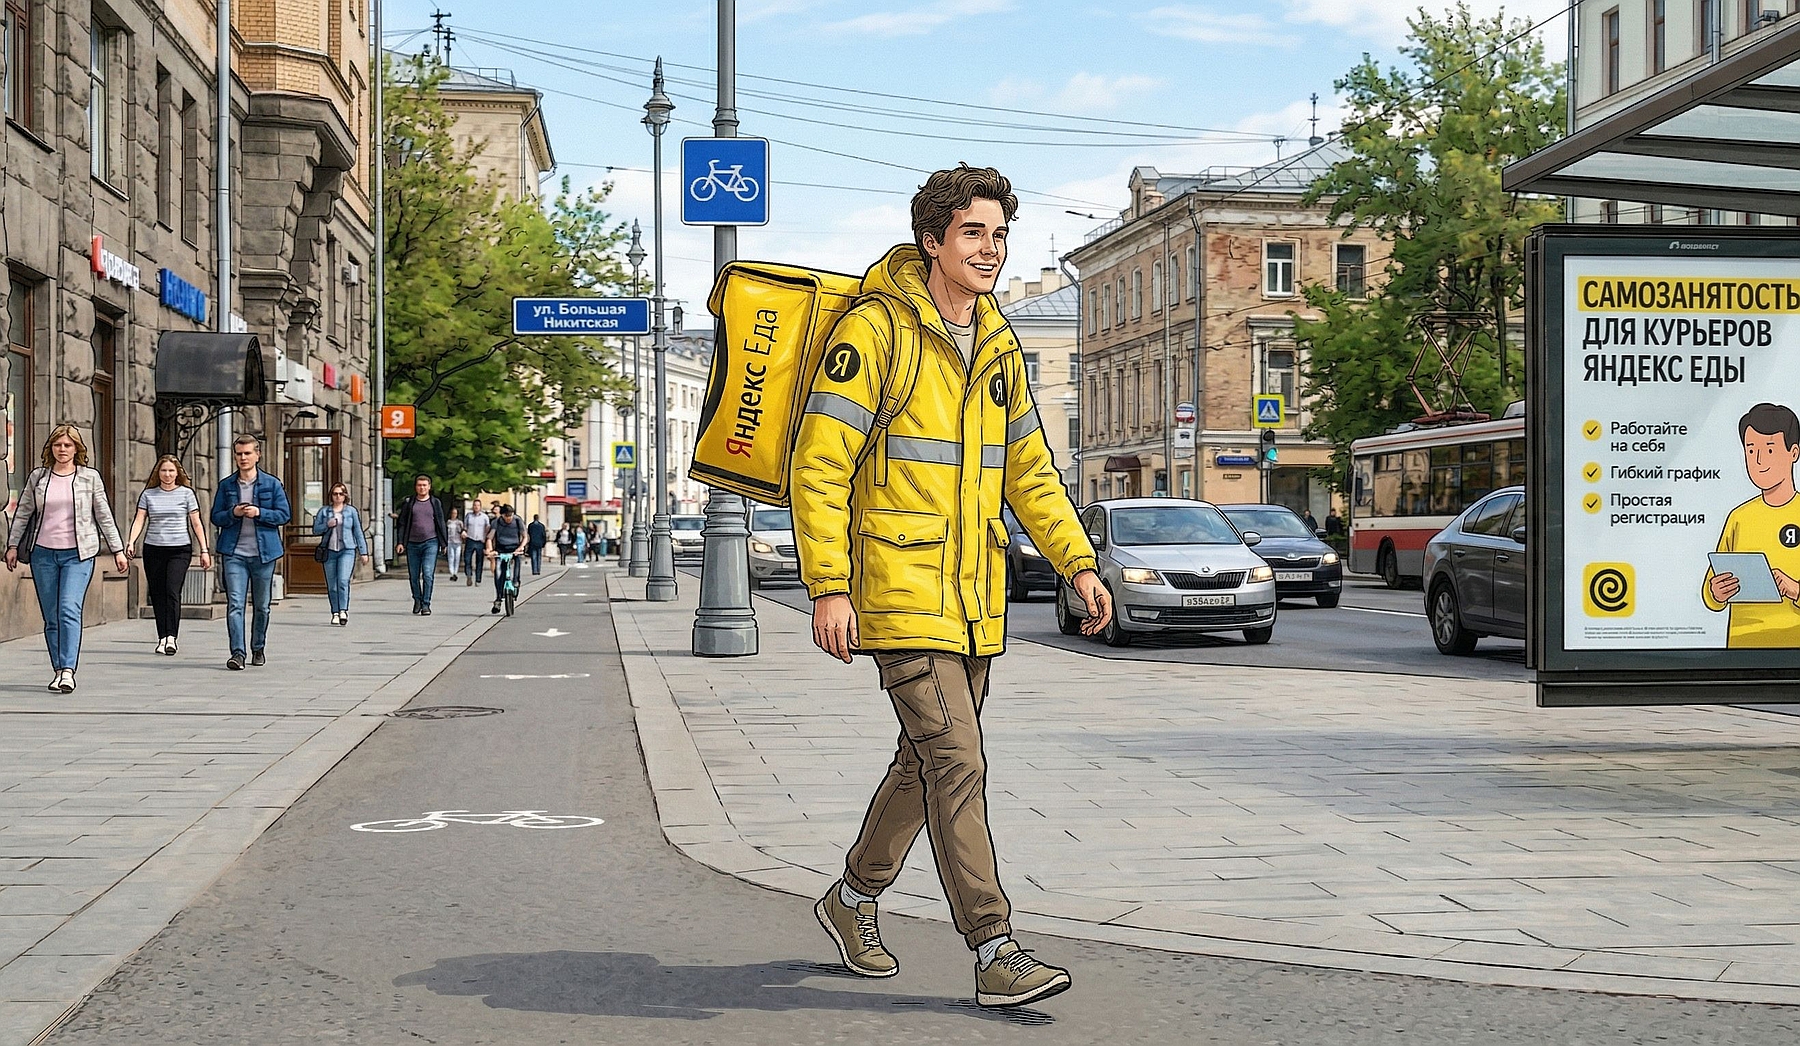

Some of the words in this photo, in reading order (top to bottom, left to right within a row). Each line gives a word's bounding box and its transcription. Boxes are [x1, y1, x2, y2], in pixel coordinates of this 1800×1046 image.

[1583, 280, 1800, 310] САМОЗАНЯТОСТЬ
[533, 305, 555, 317] ул.
[559, 303, 627, 315] Большая
[543, 317, 619, 328] Никитская
[743, 309, 779, 356] Еда
[1583, 317, 1636, 350] ДЛЯ
[1644, 318, 1772, 347] КУРЬЕРОВ
[830, 350, 851, 377] Я
[1583, 354, 1683, 387] ЯНДЕКС
[1690, 355, 1745, 388] ЕДЫ
[726, 362, 767, 459] Яндекс
[1611, 421, 1688, 435] Работайте
[1611, 441, 1628, 452] на
[1631, 438, 1666, 452] себя
[1611, 465, 1663, 479] Гибкий
[1667, 466, 1721, 483] график
[1611, 493, 1672, 508] Простая
[1611, 512, 1705, 527] регистрация
[1785, 528, 1796, 544] Я
